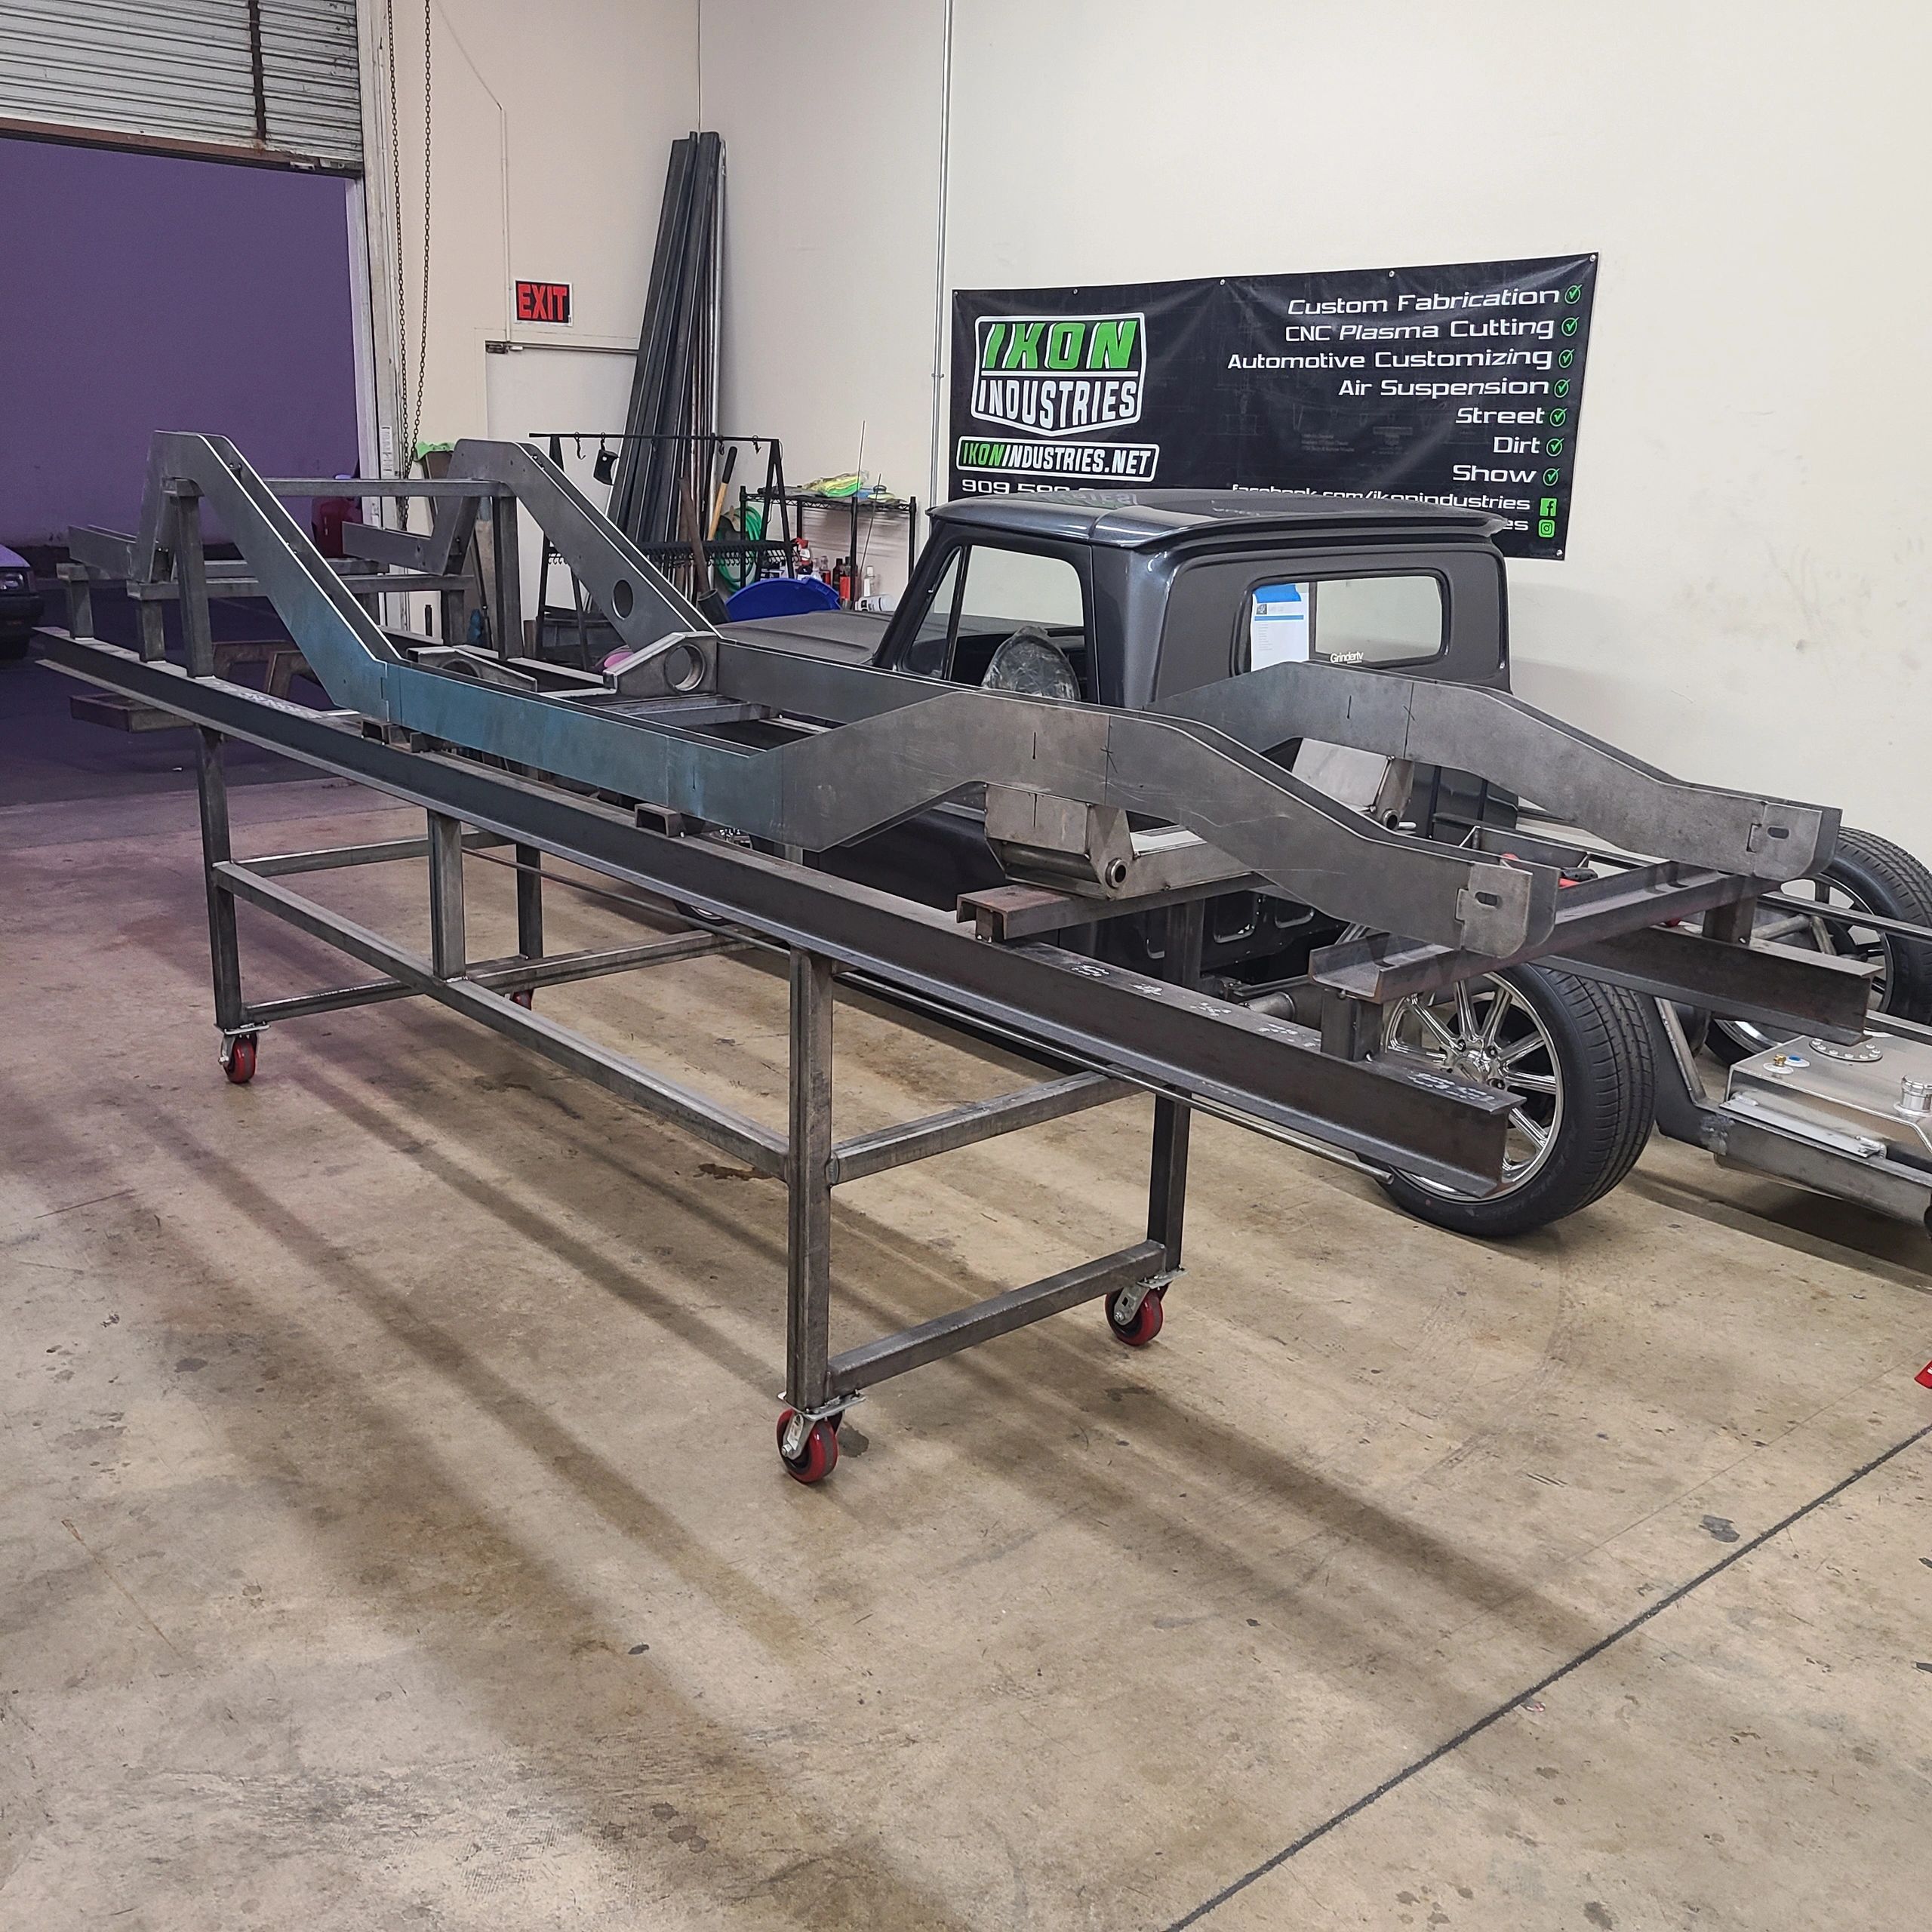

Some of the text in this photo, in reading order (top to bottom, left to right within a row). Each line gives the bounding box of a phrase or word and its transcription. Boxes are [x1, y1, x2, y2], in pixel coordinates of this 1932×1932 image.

[518, 283, 567, 321] EXIT
[1287, 288, 1559, 315] Custom Fabrication
[1285, 318, 1555, 341] CNC Plasma Cutting
[982, 321, 1137, 369] IKON
[1227, 348, 1553, 371] Automotive Customizing
[1338, 377, 1549, 399] Air Suspension
[978, 380, 1137, 429] INDUSTRIES
[1455, 408, 1545, 425] Street
[1493, 436, 1540, 454] Dirt
[1452, 464, 1537, 484] Show
[962, 479, 1010, 494] 909
